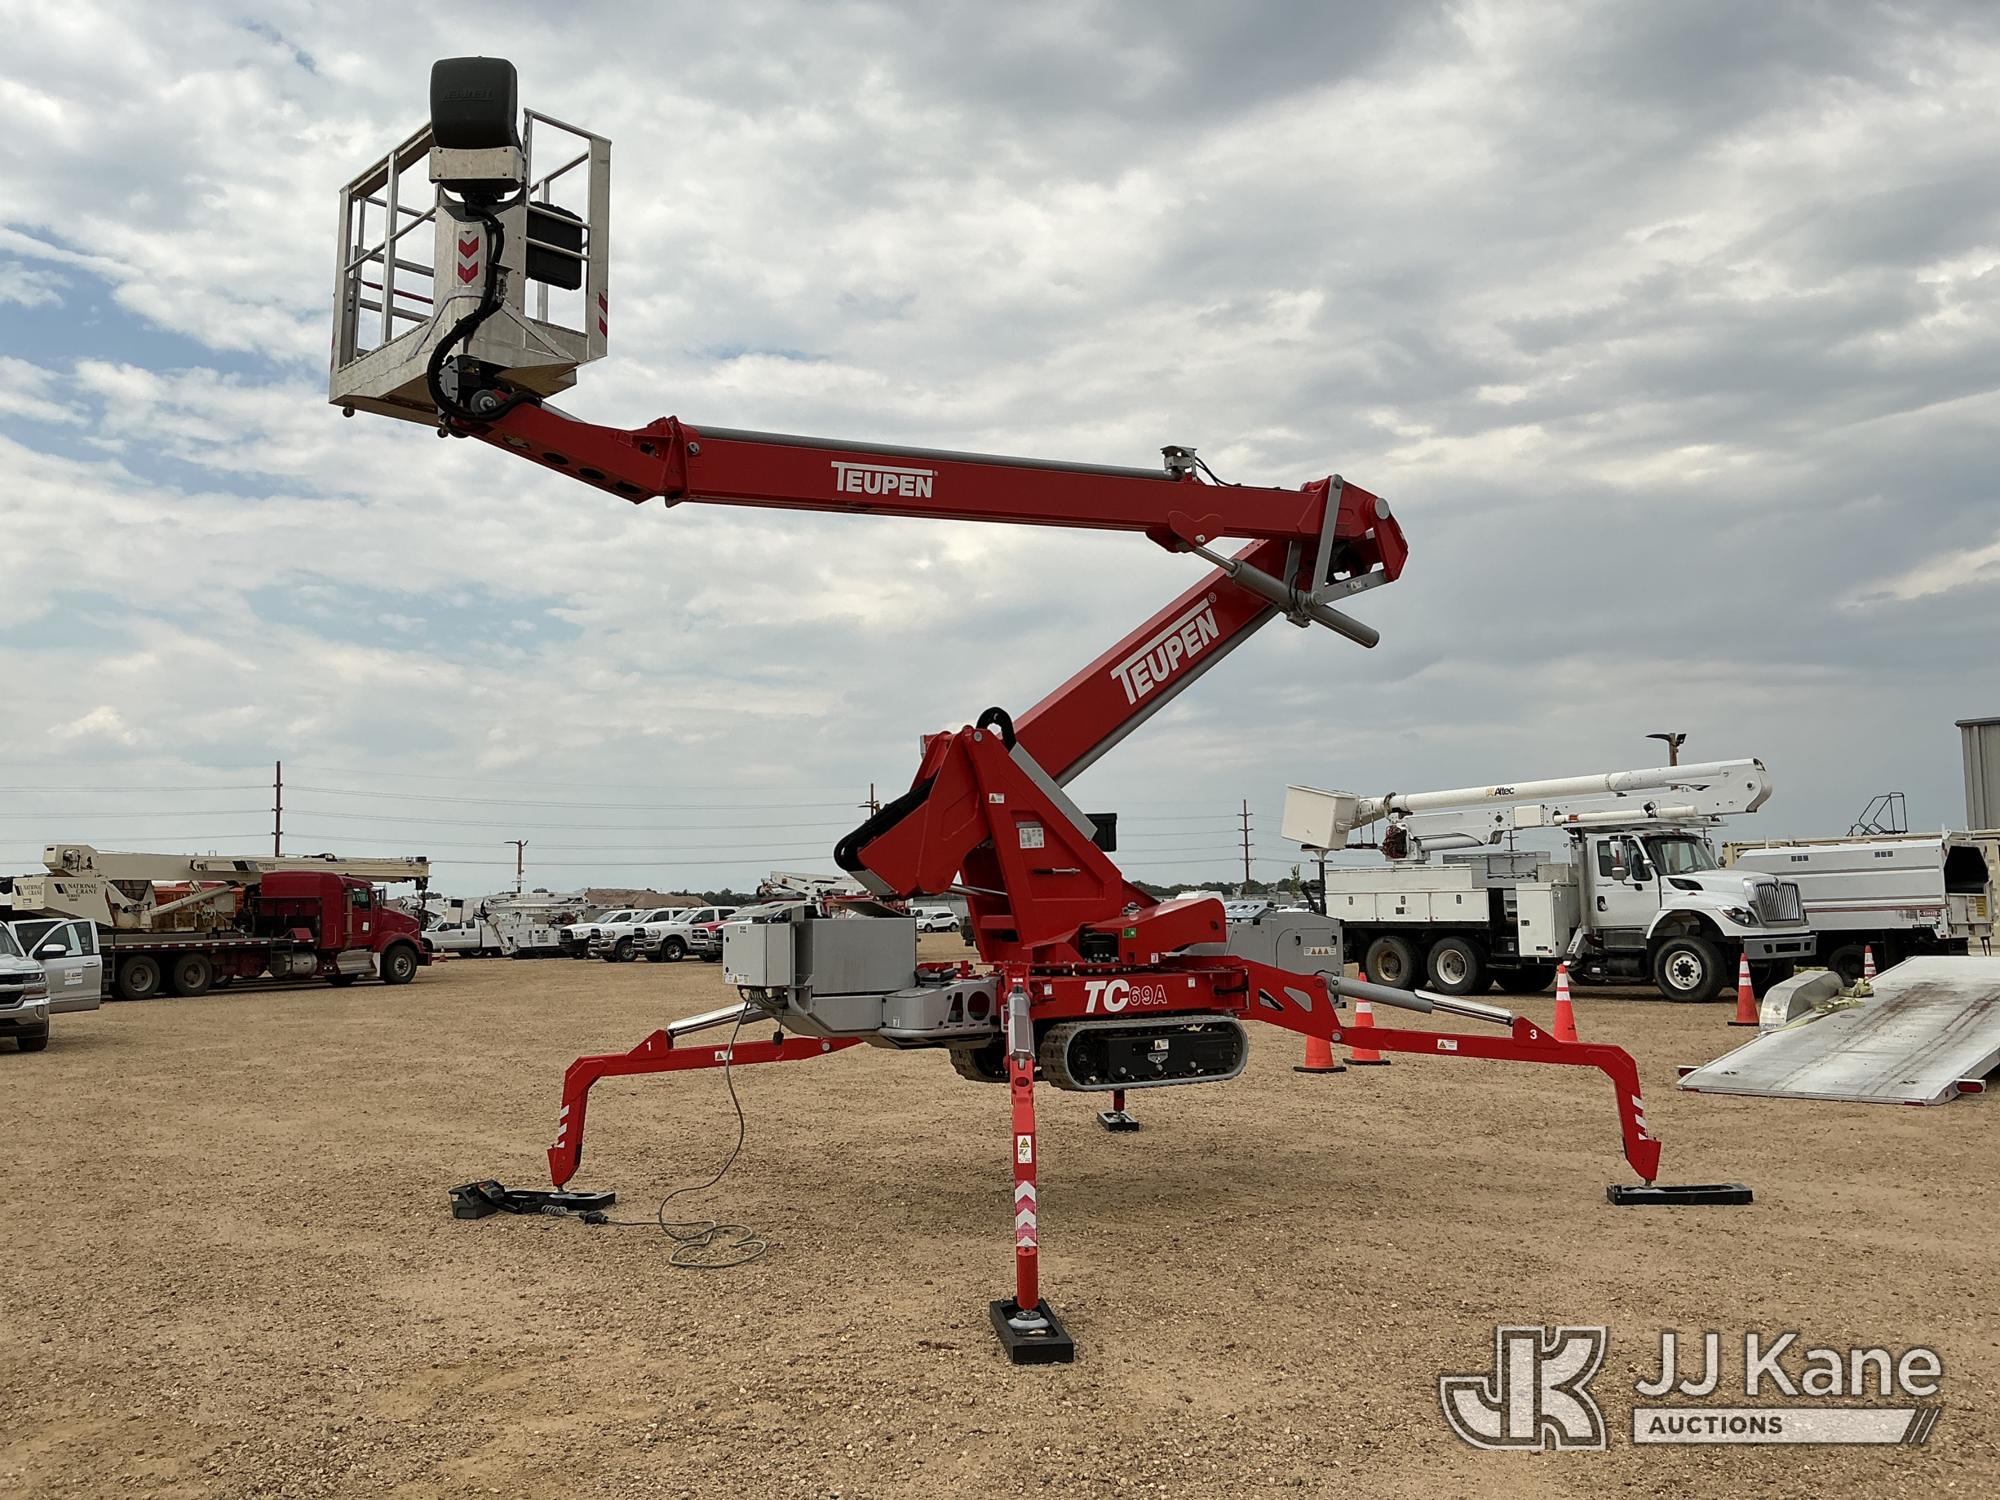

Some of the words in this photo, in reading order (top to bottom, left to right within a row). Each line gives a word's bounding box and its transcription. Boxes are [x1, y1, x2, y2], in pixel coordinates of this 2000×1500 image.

[830, 461, 933, 498] TEUPEN
[1109, 597, 1220, 705] TEUPEN
[1494, 787, 1515, 796] Altec
[1530, 1029, 1538, 1040] 3
[646, 1041, 652, 1052] 1
